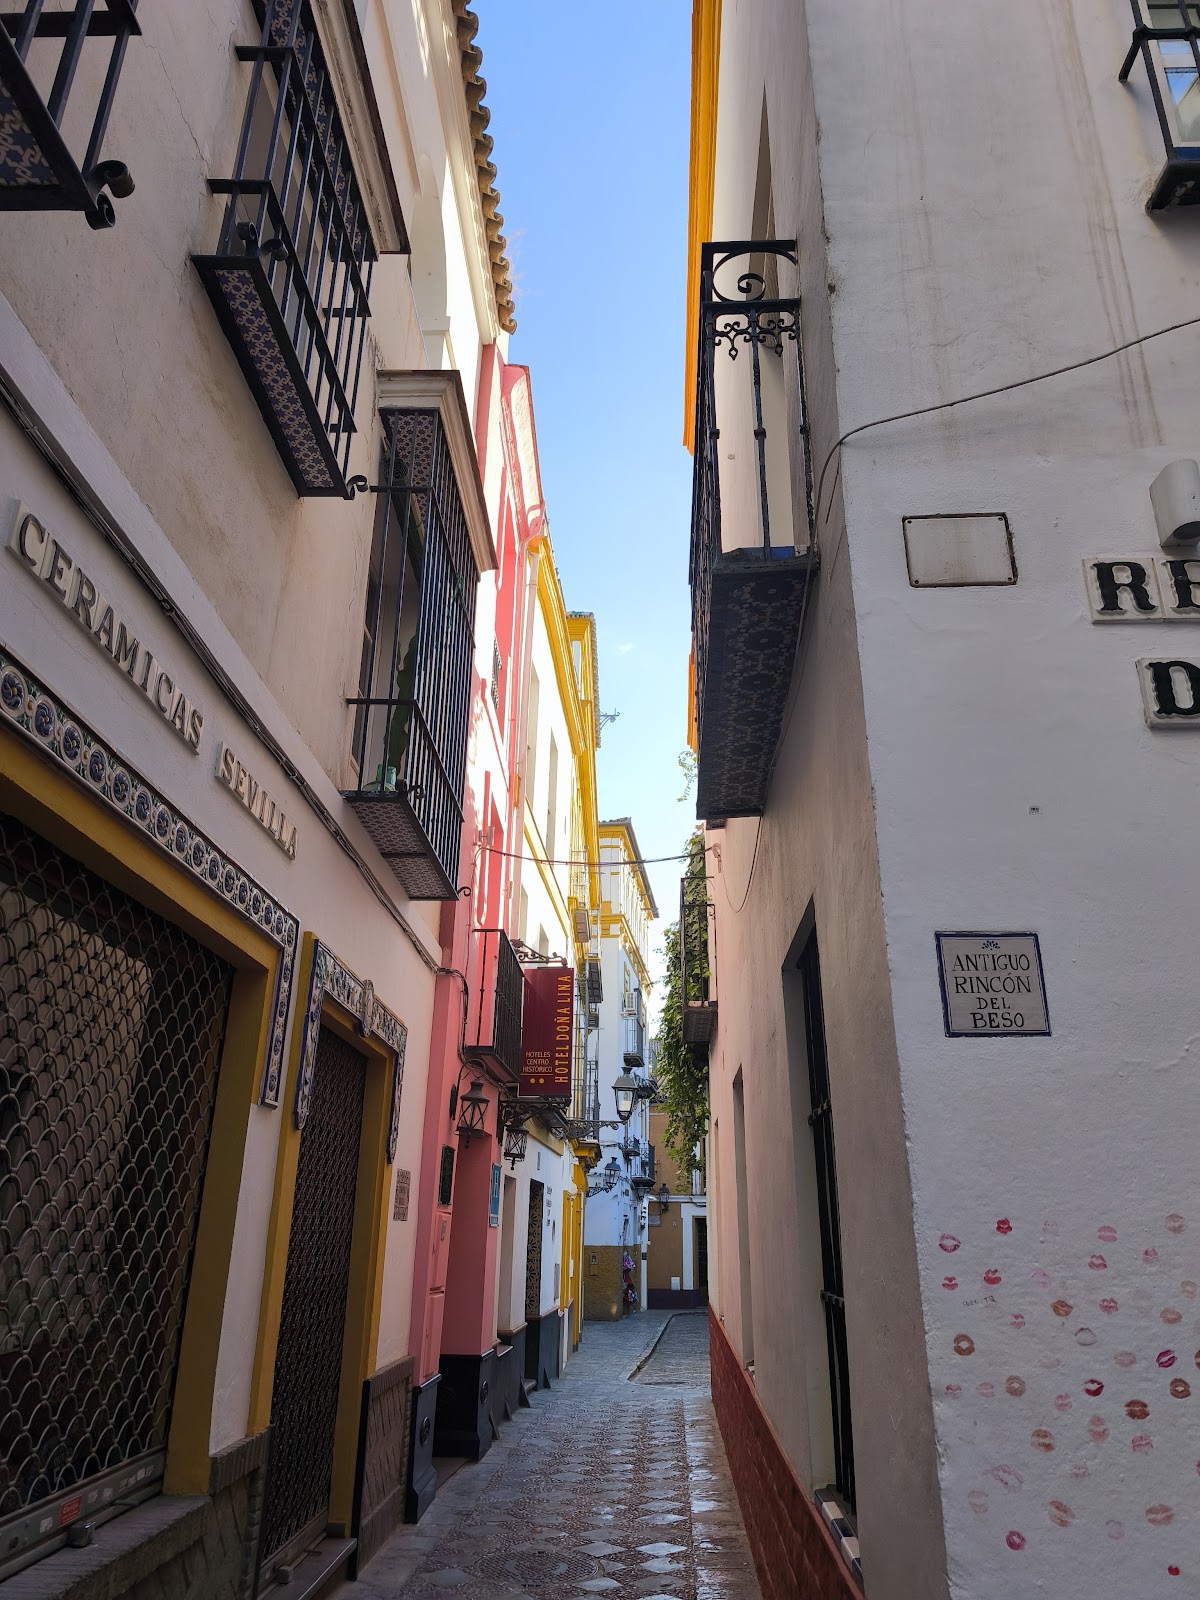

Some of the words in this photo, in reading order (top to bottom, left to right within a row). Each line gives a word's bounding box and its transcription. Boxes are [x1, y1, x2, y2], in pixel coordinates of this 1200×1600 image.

[19, 513, 204, 748] CERAMICAS
[221, 748, 297, 858] SEVILLA
[951, 953, 1031, 972] ANTIGUO
[557, 975, 571, 1003] LINA
[953, 972, 1032, 994] RINCÓN
[975, 996, 1011, 1010] DEL
[554, 1007, 571, 1040] DOÑA
[969, 1011, 1025, 1029] BESO
[522, 1065, 553, 1073] HISTÓRICO
[554, 1044, 569, 1083] HOTEL
